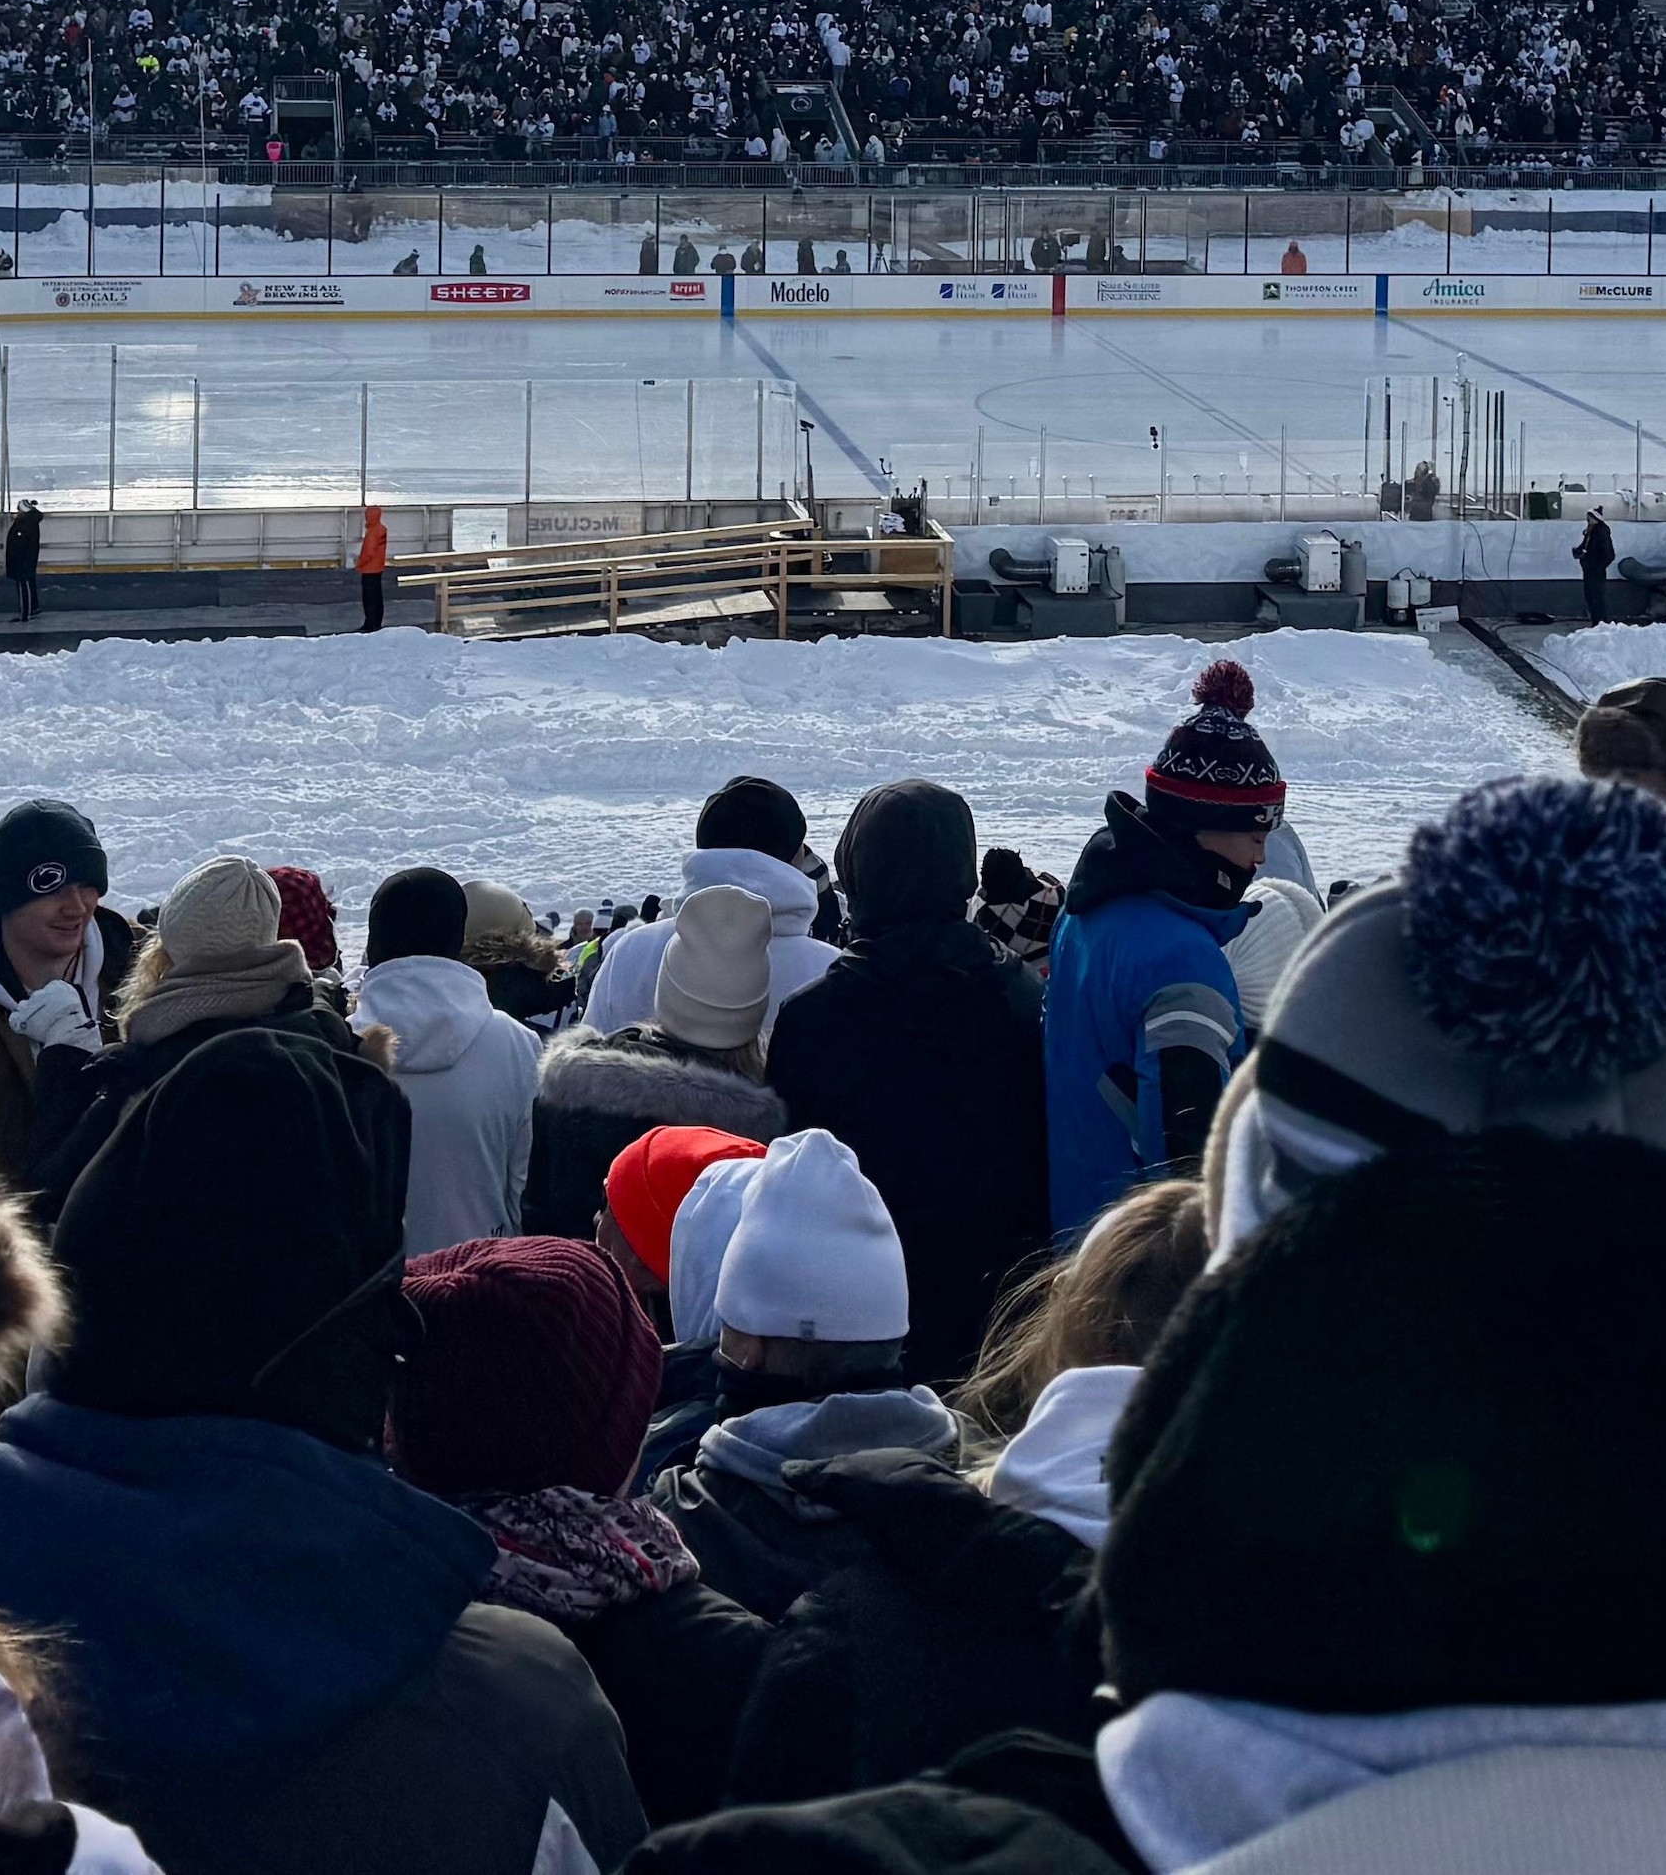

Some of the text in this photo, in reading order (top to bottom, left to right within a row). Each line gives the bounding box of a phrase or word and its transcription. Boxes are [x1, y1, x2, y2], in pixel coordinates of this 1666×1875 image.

[437, 287, 525, 298] SHEETZ
[771, 281, 830, 303] Modelo
[1423, 278, 1485, 296] Amica
[73, 292, 128, 302] LOCAL 5
